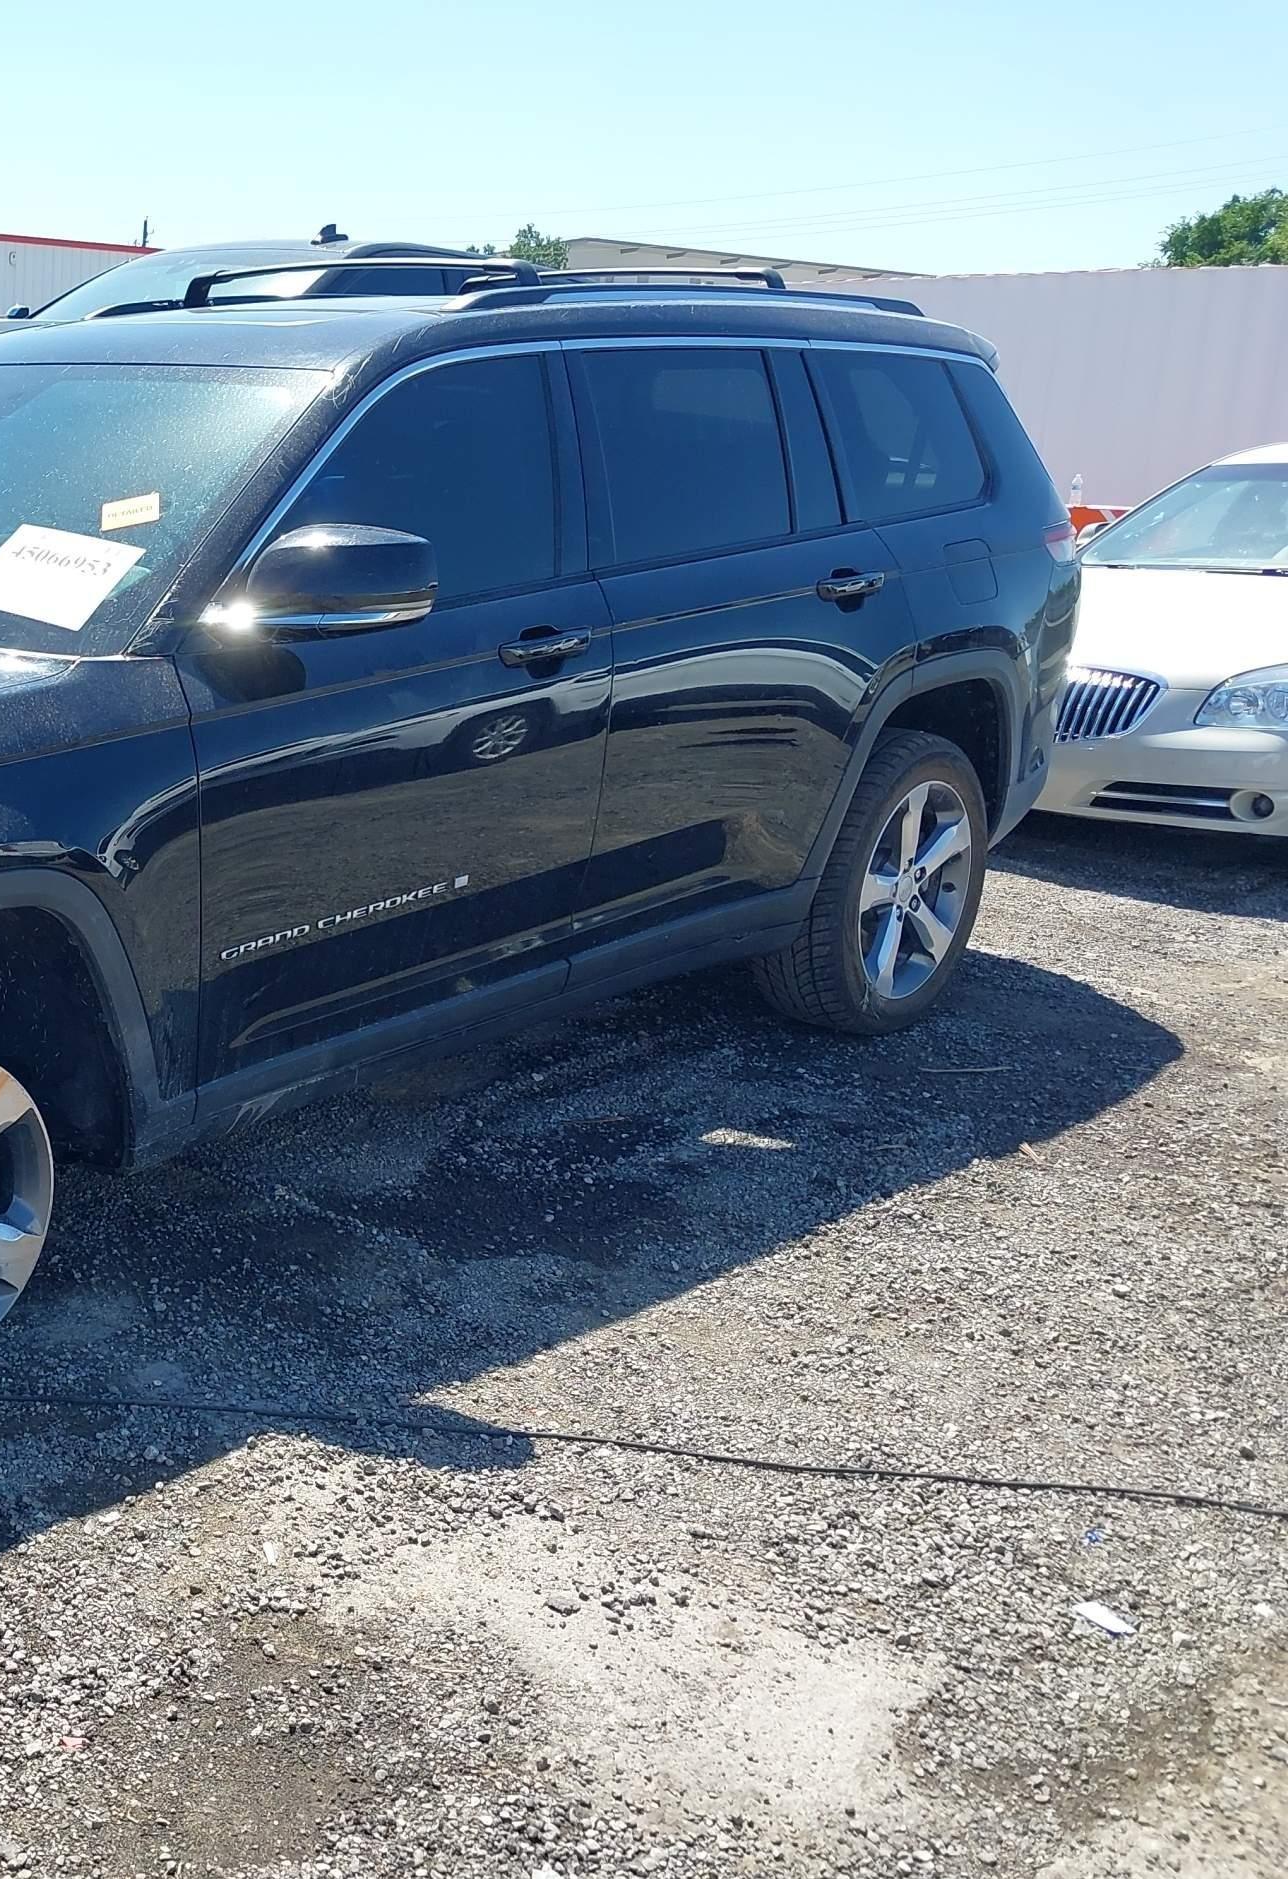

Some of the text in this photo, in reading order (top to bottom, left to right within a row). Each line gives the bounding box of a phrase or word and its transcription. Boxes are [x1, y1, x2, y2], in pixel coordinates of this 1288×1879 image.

[11, 545, 112, 576] 45066953
[220, 882, 448, 961] GRAND CHEROKEE
